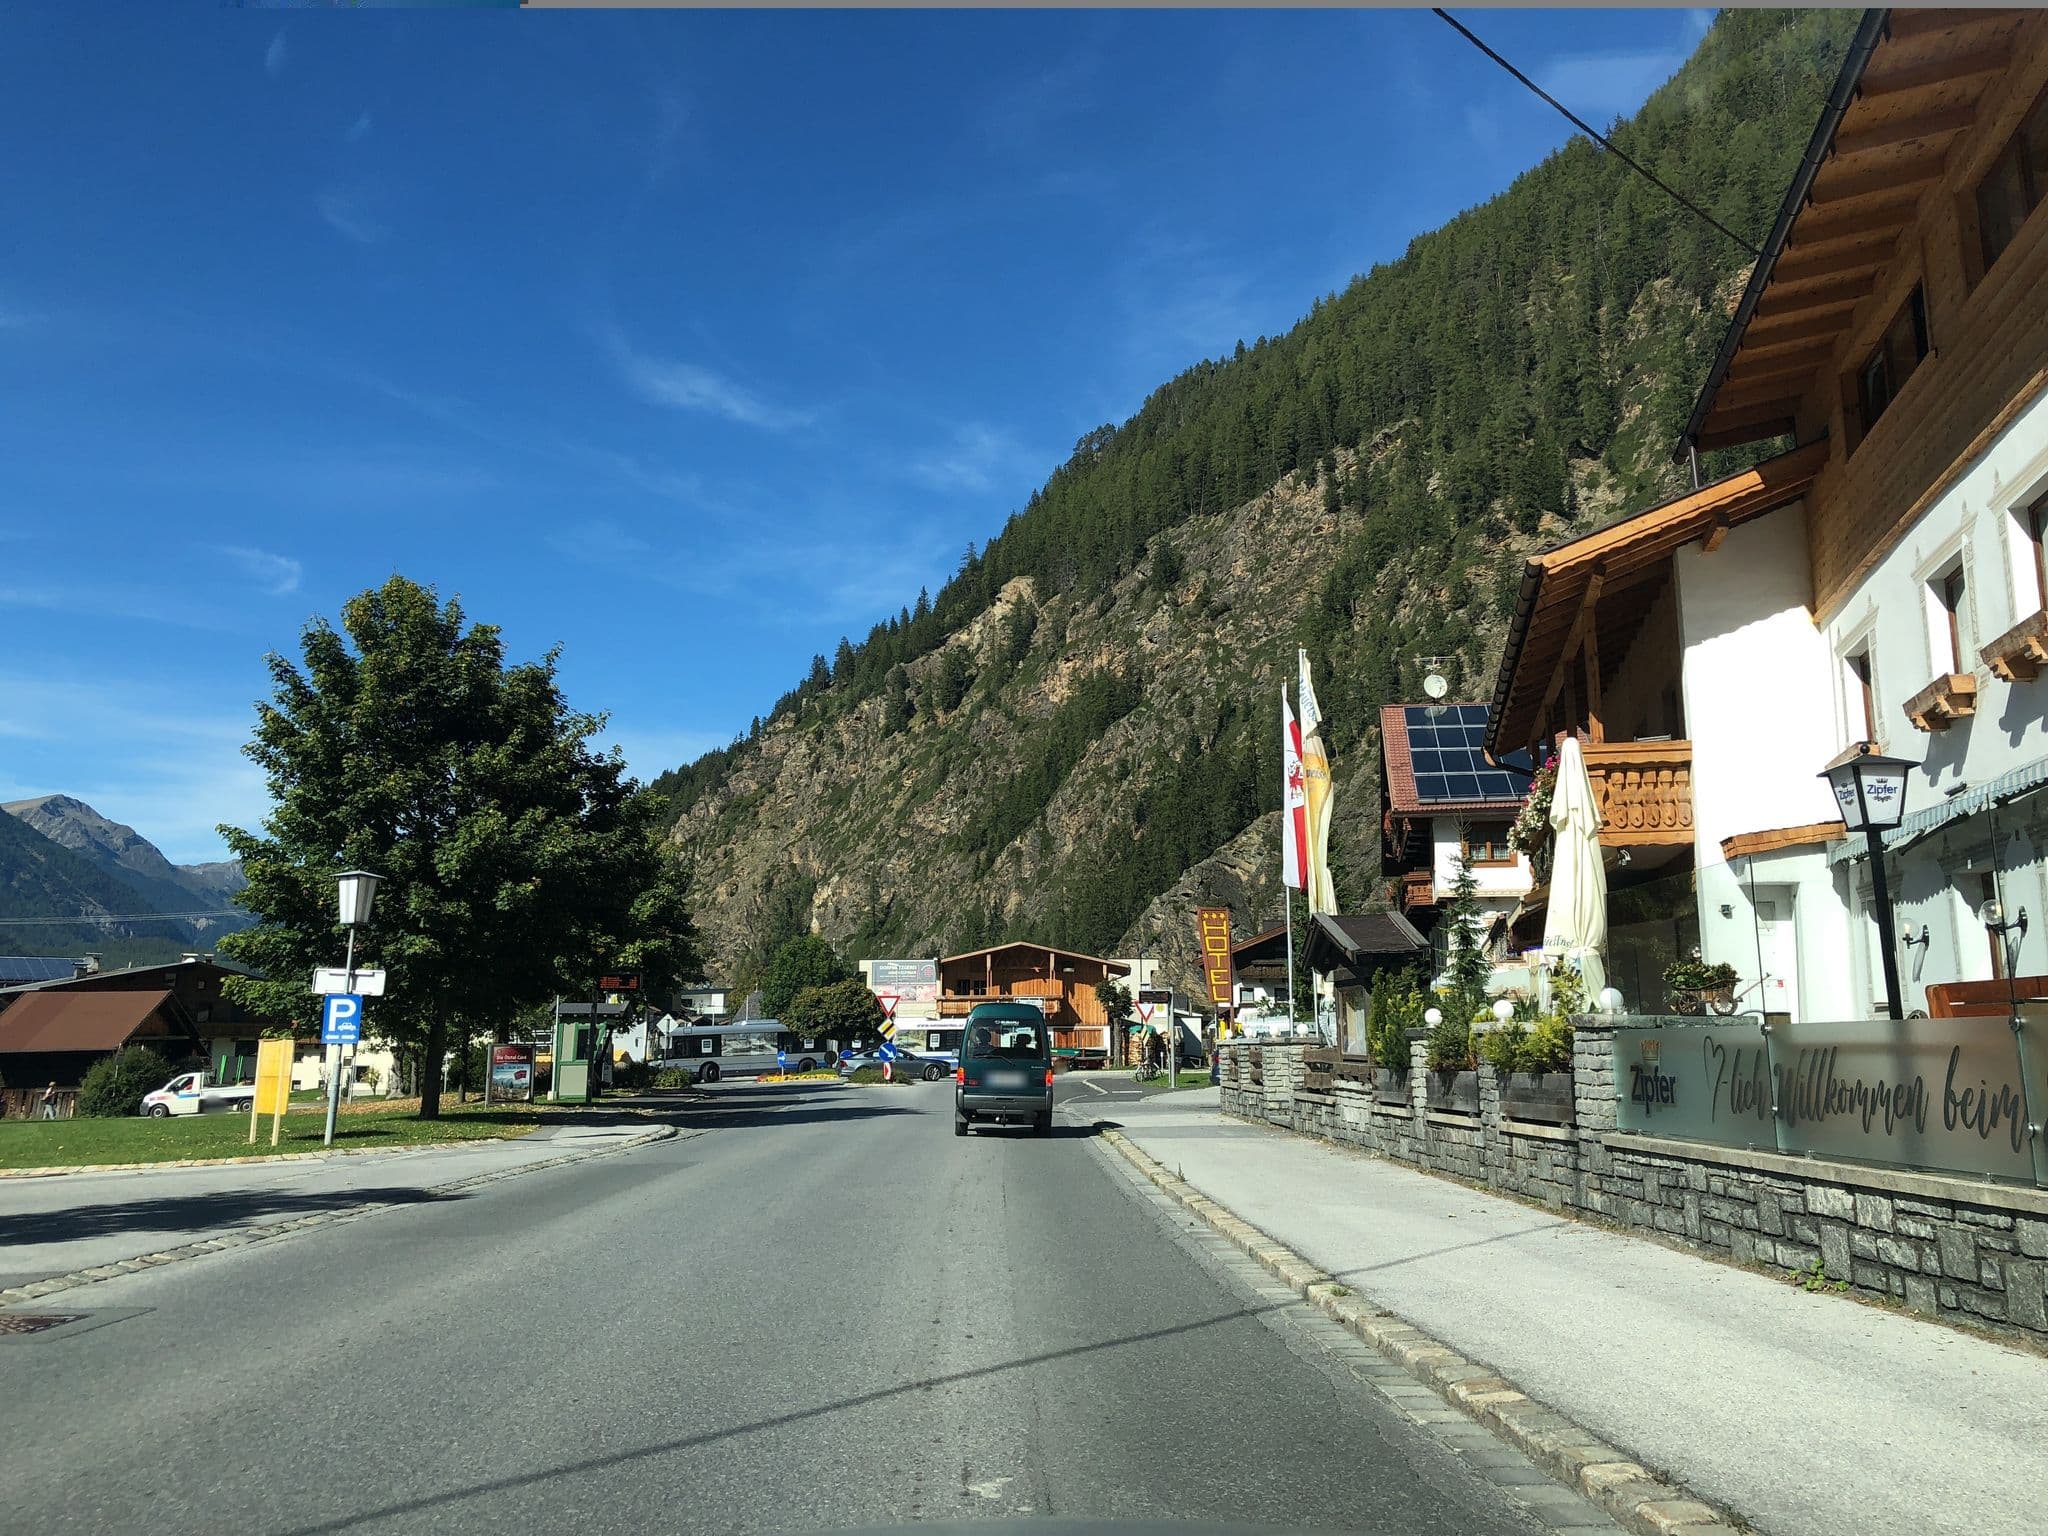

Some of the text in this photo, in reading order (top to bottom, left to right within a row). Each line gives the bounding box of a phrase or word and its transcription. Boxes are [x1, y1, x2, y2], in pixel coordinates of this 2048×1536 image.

[1838, 788, 1855, 800] Zipfer
[1867, 784, 1898, 797] Zipfer
[1203, 920, 1230, 1001] HOTEL
[328, 998, 357, 1031] P
[1630, 1064, 1675, 1114] Zipfer
[1773, 1046, 1929, 1135] Willkommen
[1943, 1045, 2026, 1153] beim
